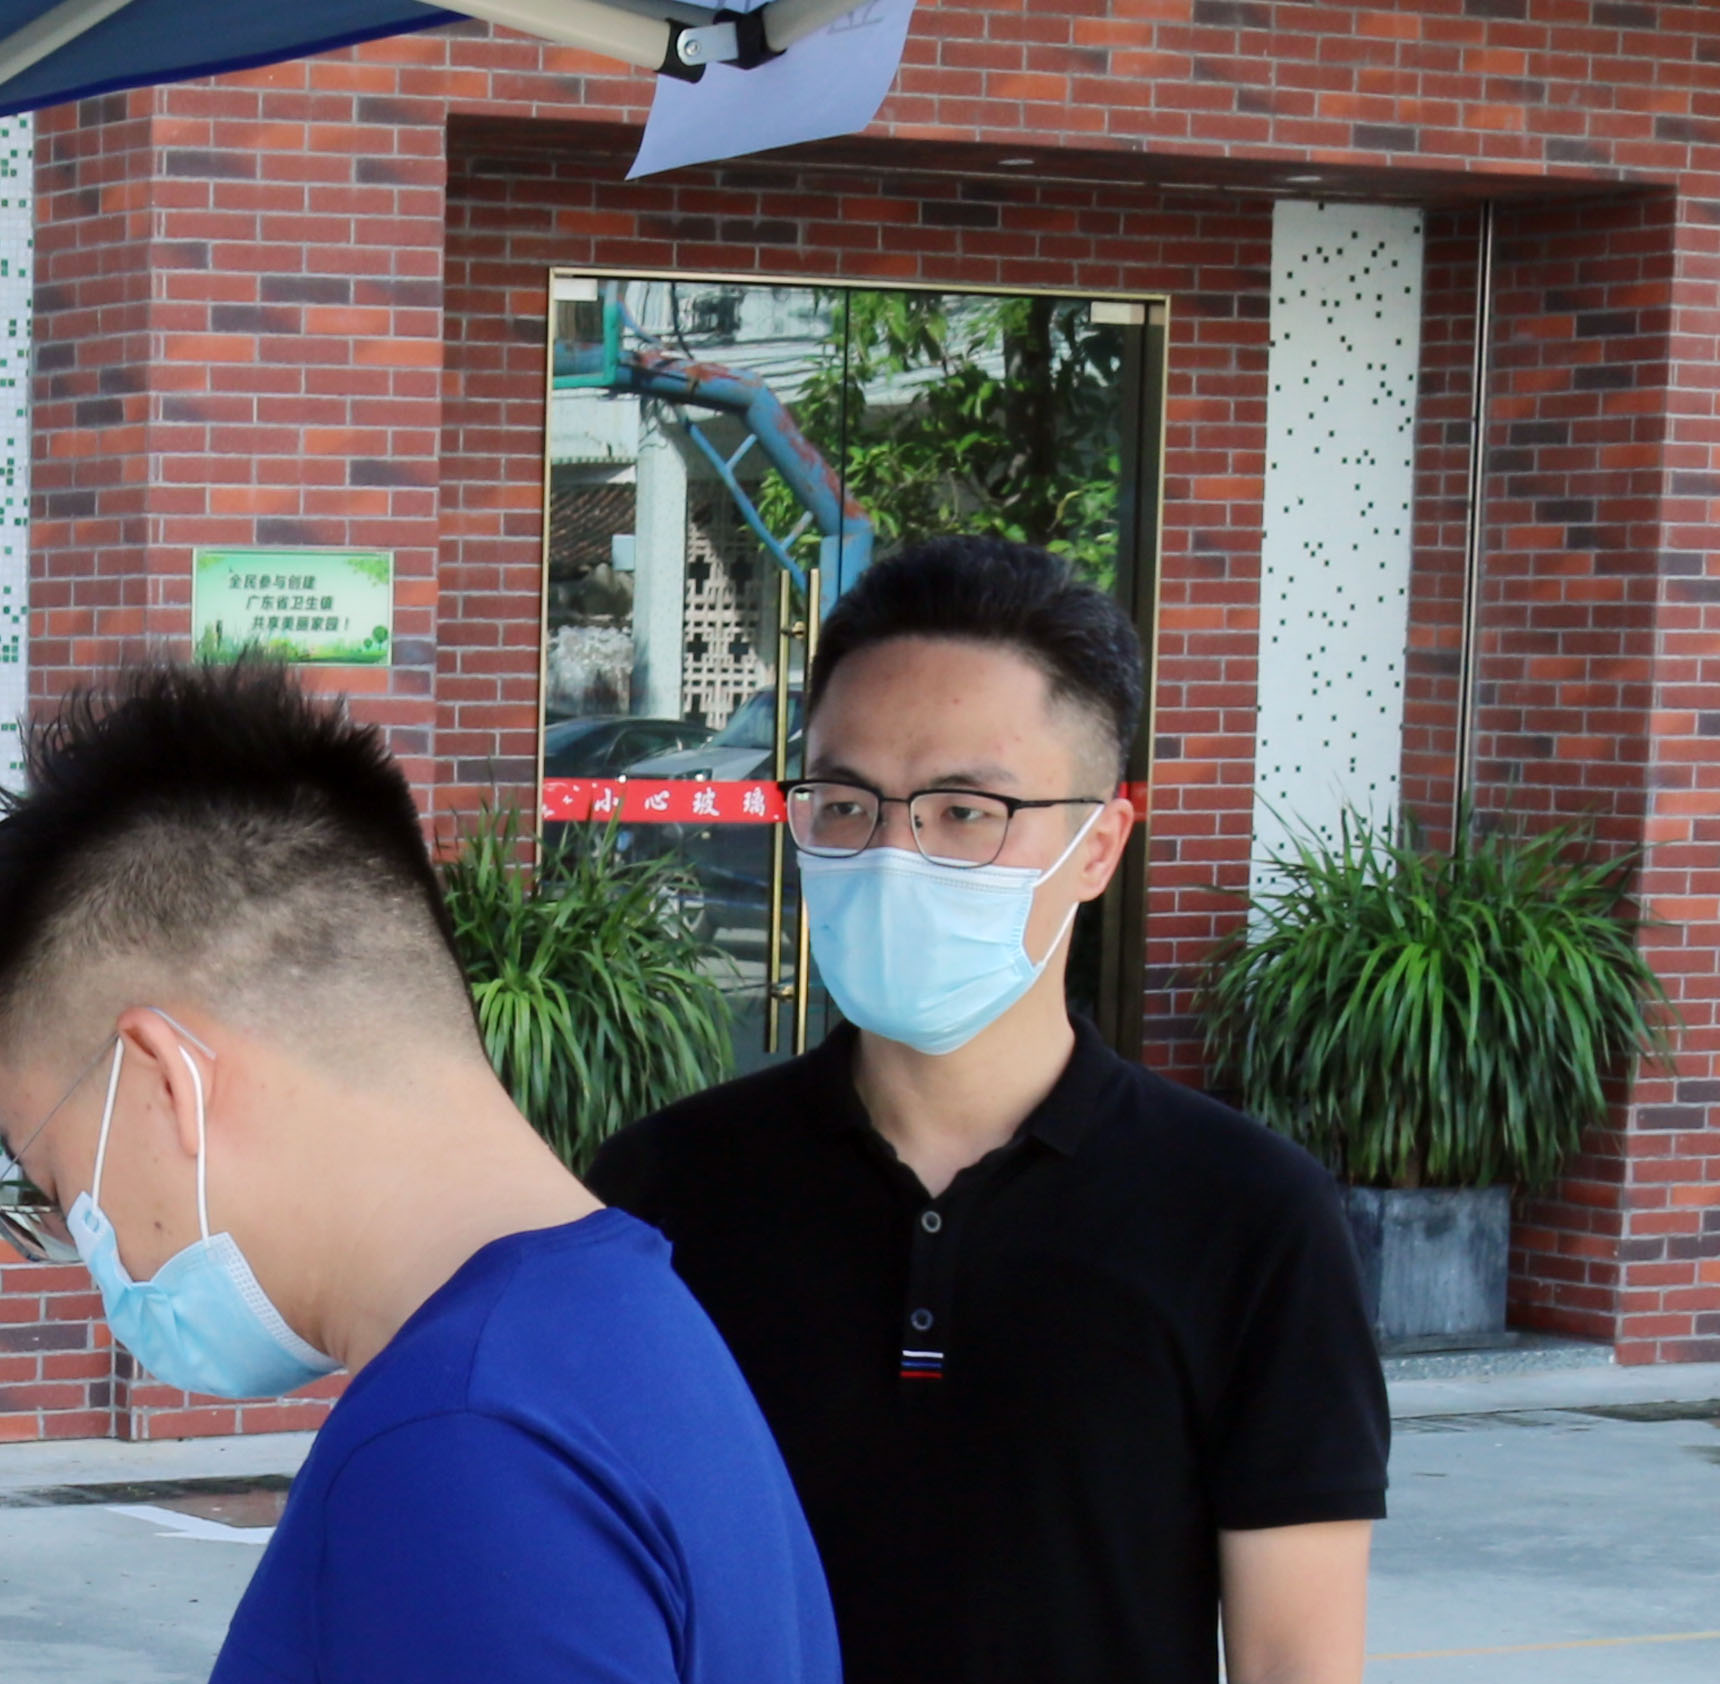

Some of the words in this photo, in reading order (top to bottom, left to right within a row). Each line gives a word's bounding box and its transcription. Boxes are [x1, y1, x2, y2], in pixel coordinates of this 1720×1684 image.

[228, 574, 317, 590] 全民参与创建
[245, 595, 335, 611] 广东省卫生镇
[593, 786, 770, 817] 小心玻璃
